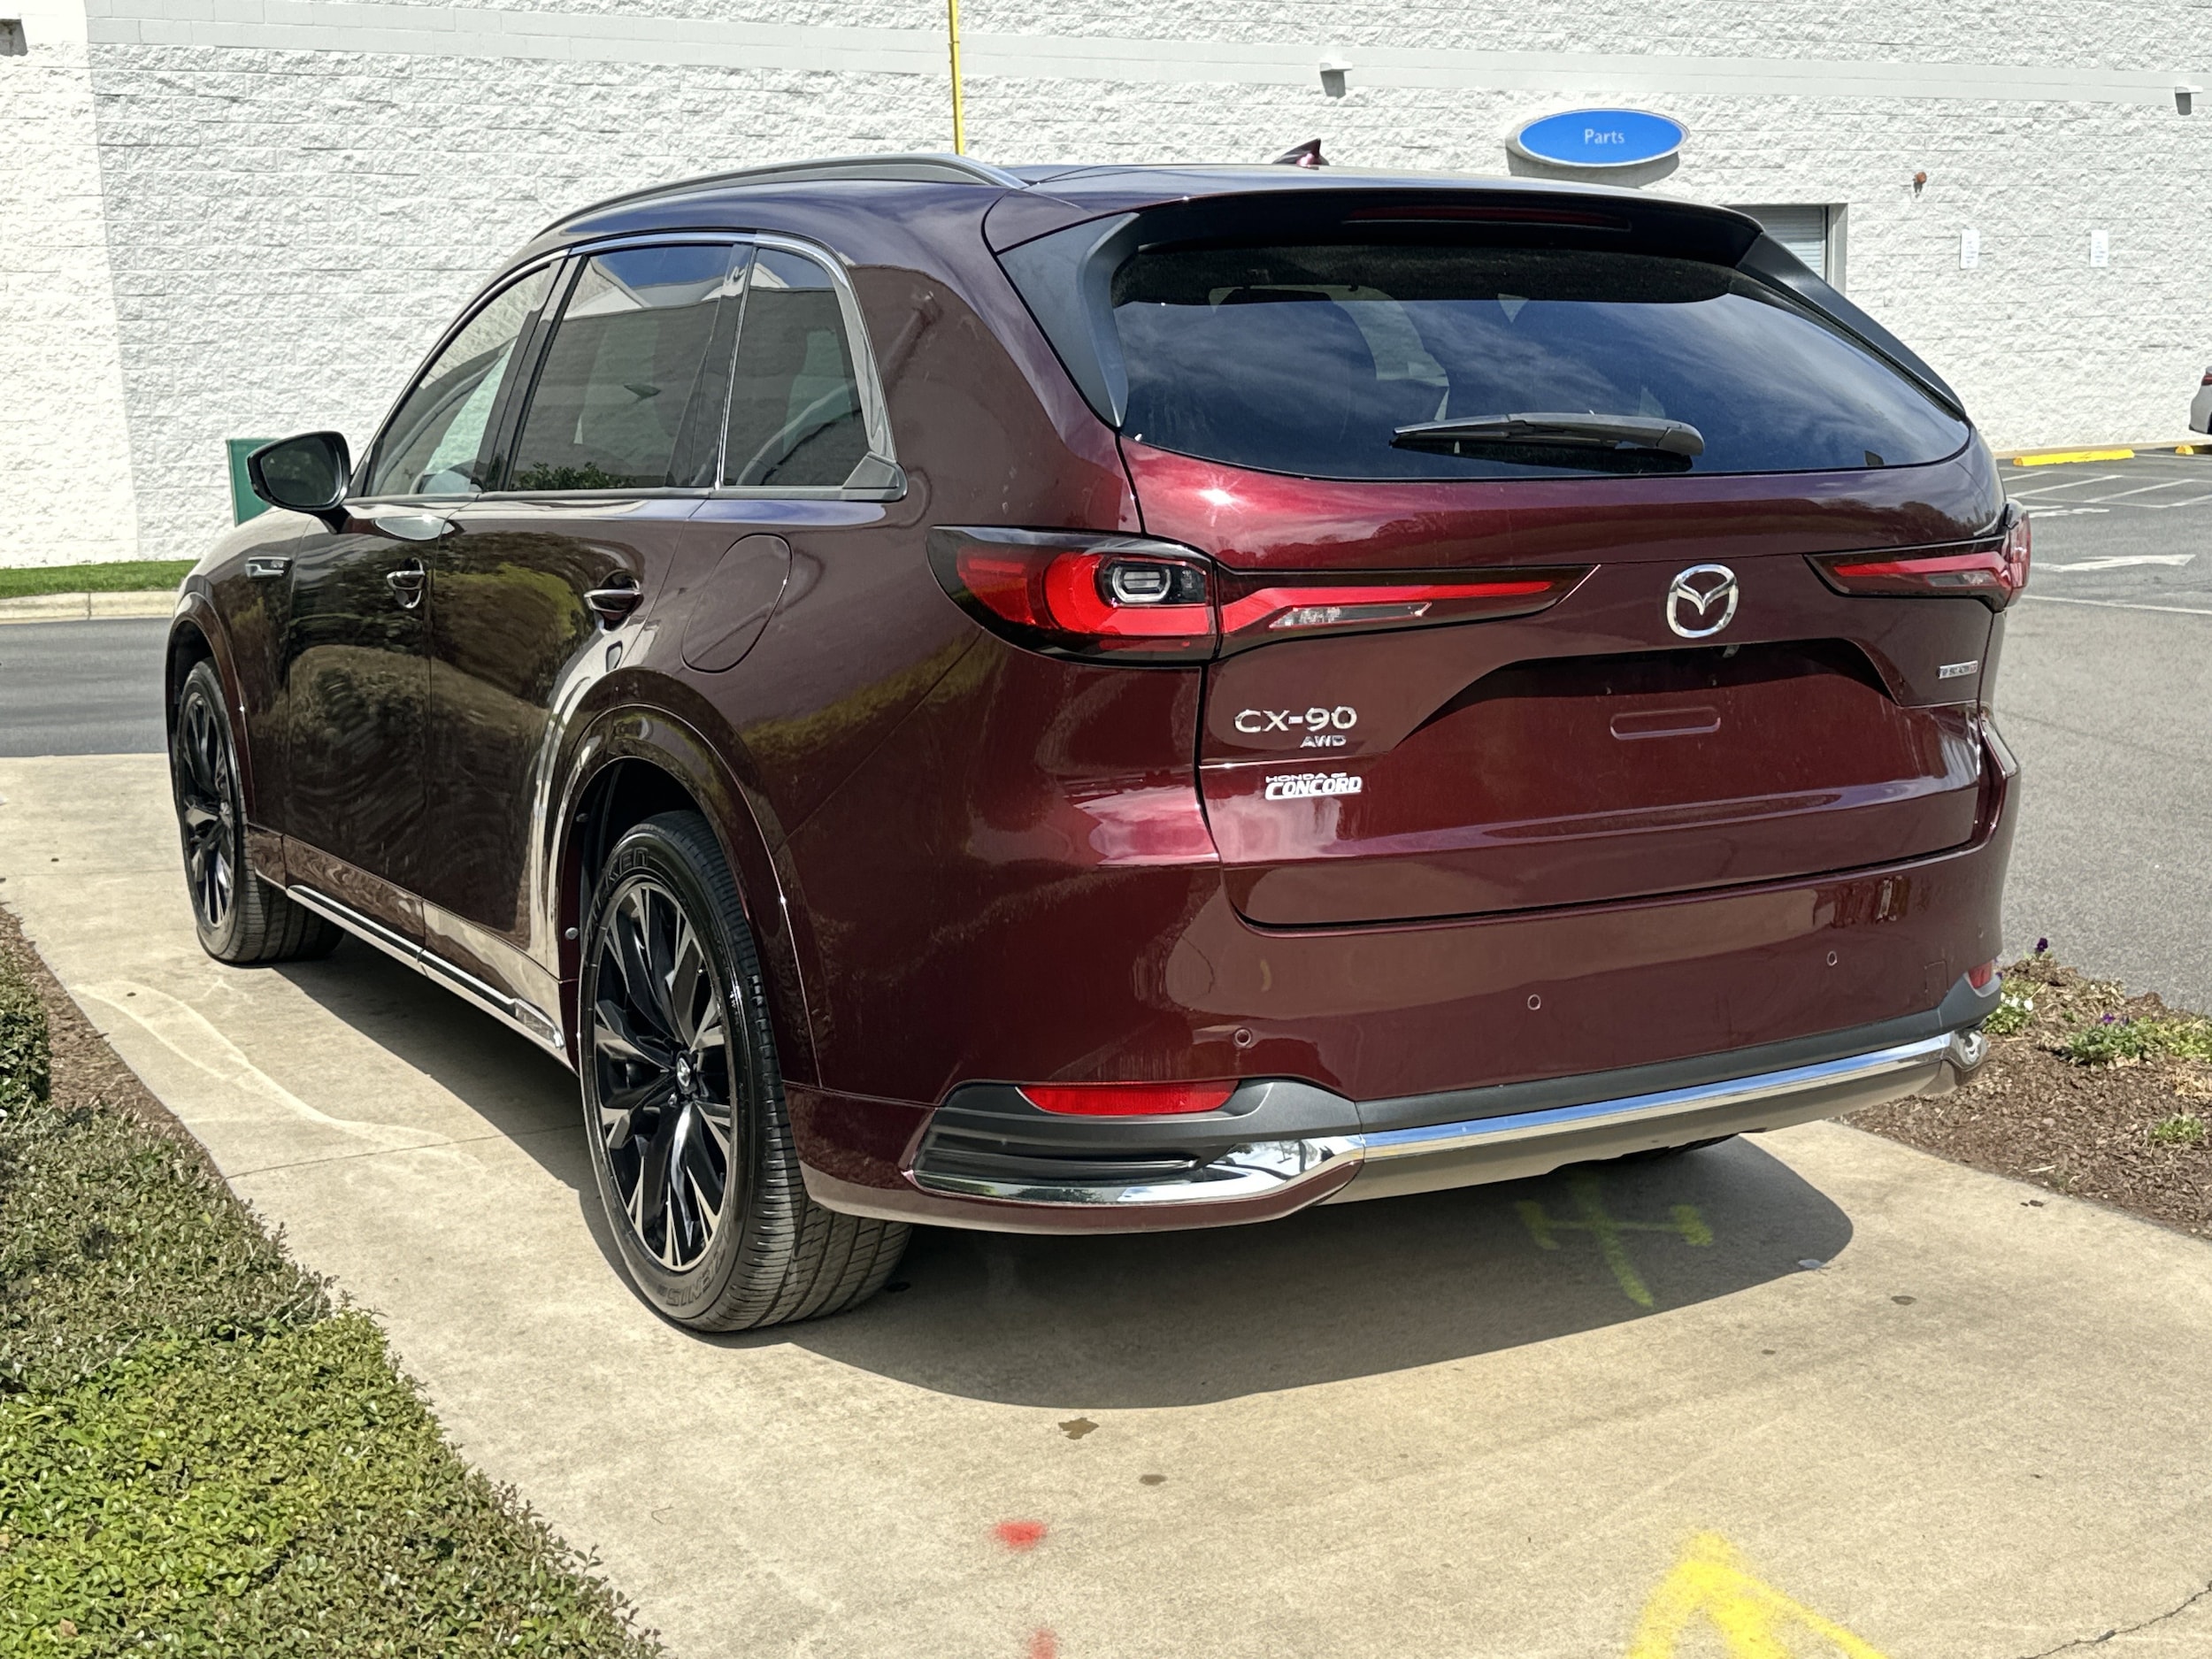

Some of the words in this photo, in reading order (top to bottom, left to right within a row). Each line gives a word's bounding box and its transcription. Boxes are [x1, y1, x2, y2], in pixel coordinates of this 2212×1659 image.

[1584, 128, 1624, 144] Parts
[1234, 706, 1358, 733] CX-90
[1300, 735, 1347, 749] AWD
[1265, 772, 1328, 783] HONDA
[1265, 776, 1363, 800] CONCORD
